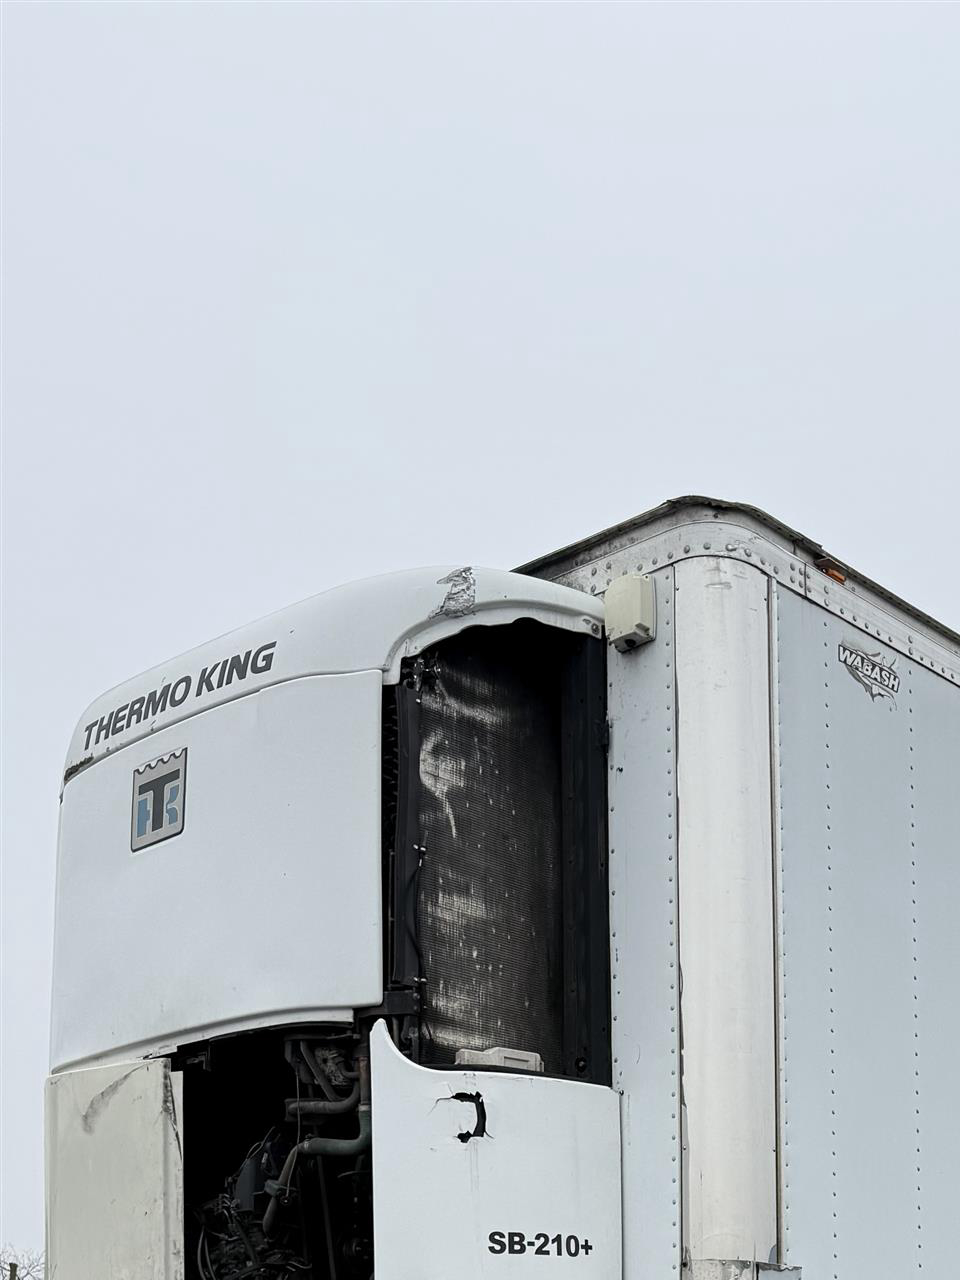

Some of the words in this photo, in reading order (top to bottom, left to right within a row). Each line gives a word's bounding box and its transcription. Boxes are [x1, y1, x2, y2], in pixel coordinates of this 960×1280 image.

[839, 645, 899, 692] WABASH
[84, 675, 192, 750] THERMO
[195, 641, 277, 698] KING
[488, 1231, 593, 1257] SB-210+
